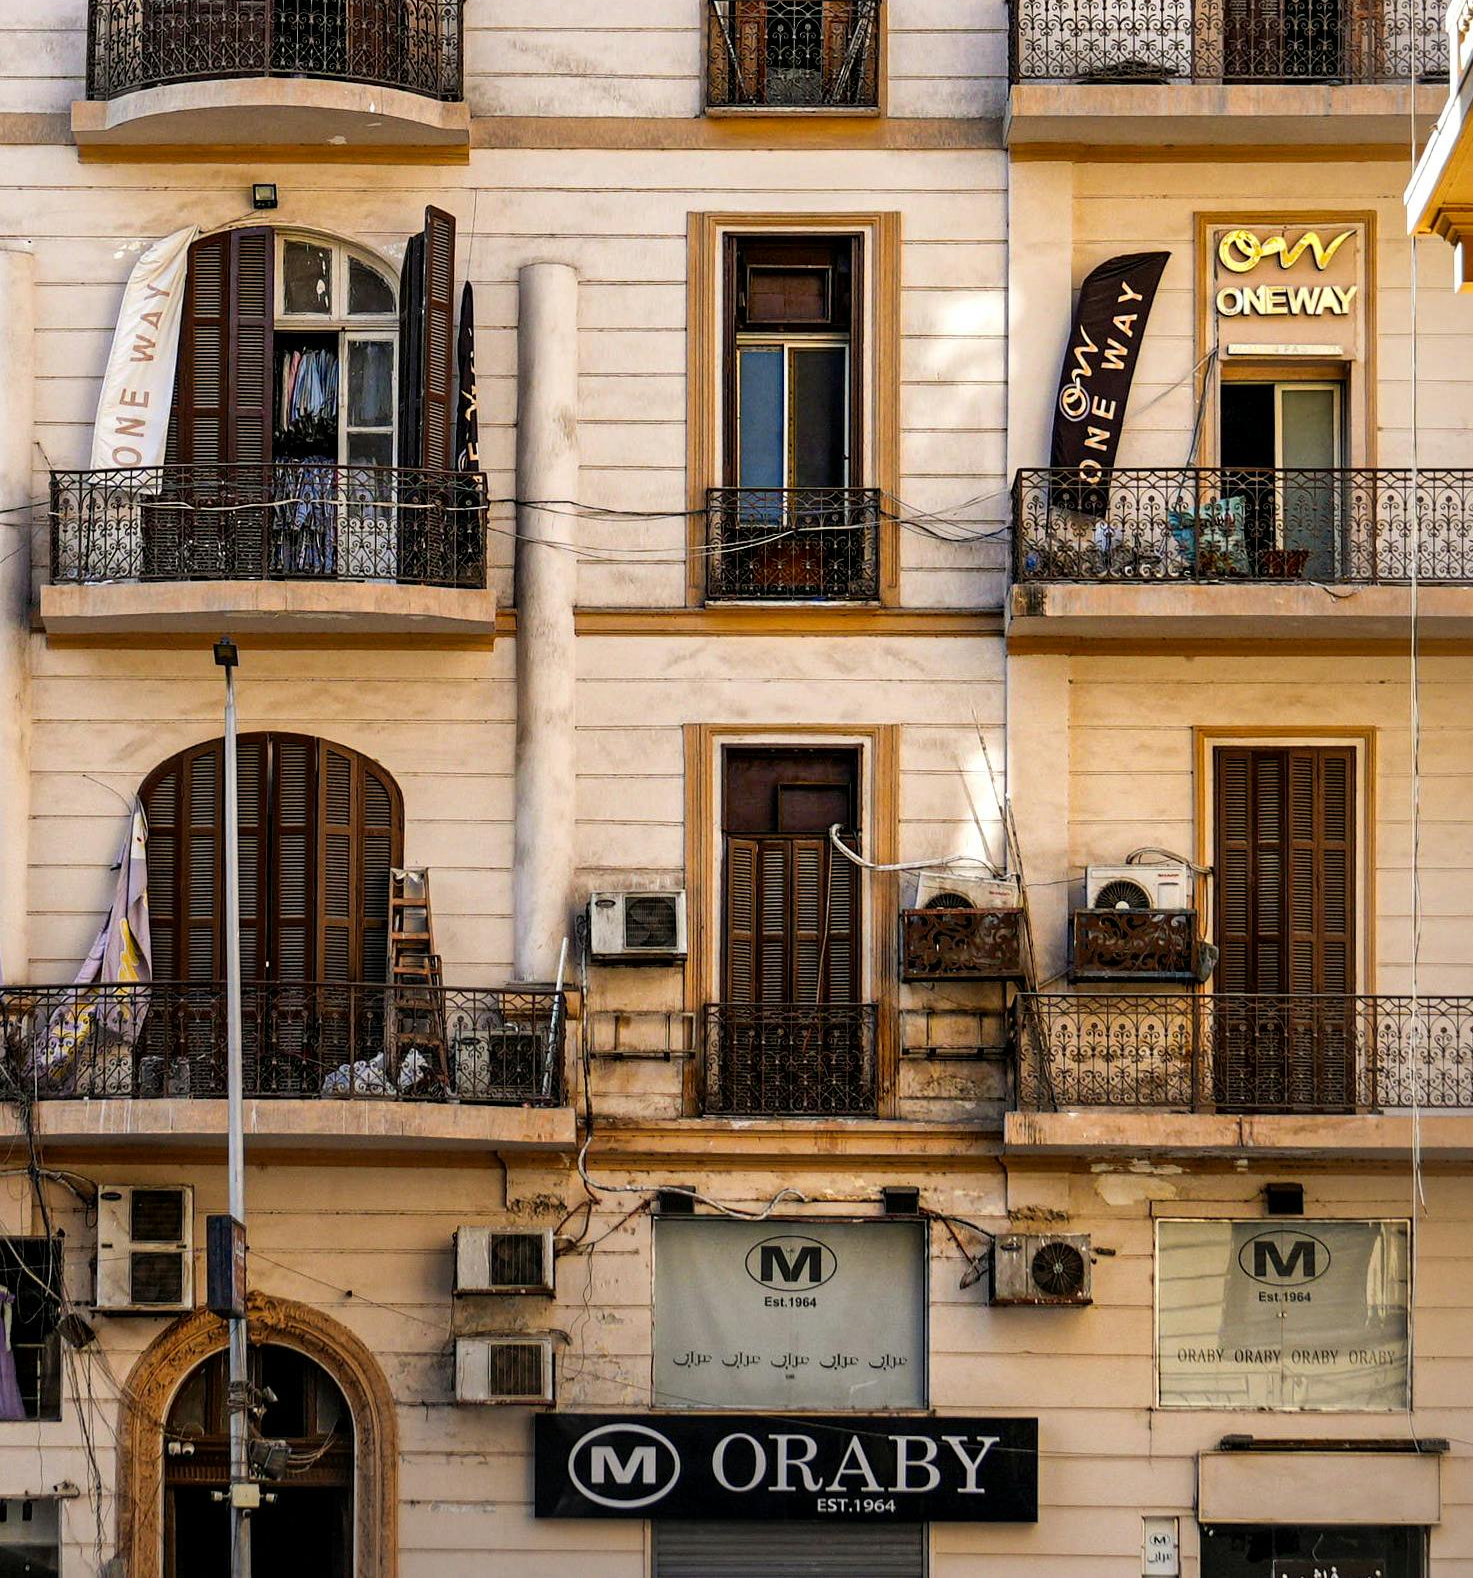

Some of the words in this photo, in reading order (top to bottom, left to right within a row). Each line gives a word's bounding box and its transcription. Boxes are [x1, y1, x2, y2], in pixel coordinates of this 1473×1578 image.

[1216, 284, 1357, 317] ONEWAY
[129, 283, 172, 364] WAY
[1079, 396, 1117, 486] ONE
[1100, 280, 1144, 372] WAY
[111, 388, 151, 469] ONE
[760, 1245, 822, 1283] M
[1253, 1240, 1316, 1278] M
[764, 1296, 817, 1309] Est.1964
[1258, 1291, 1312, 1303] Est.1964
[1177, 1348, 1224, 1363] ORABY
[1234, 1349, 1281, 1364] ORABY
[1291, 1349, 1339, 1365] ORABY
[1348, 1350, 1396, 1366] ORABY
[590, 1445, 657, 1484] M
[711, 1432, 1000, 1494] ORABY
[816, 1498, 897, 1514] EST.1964
